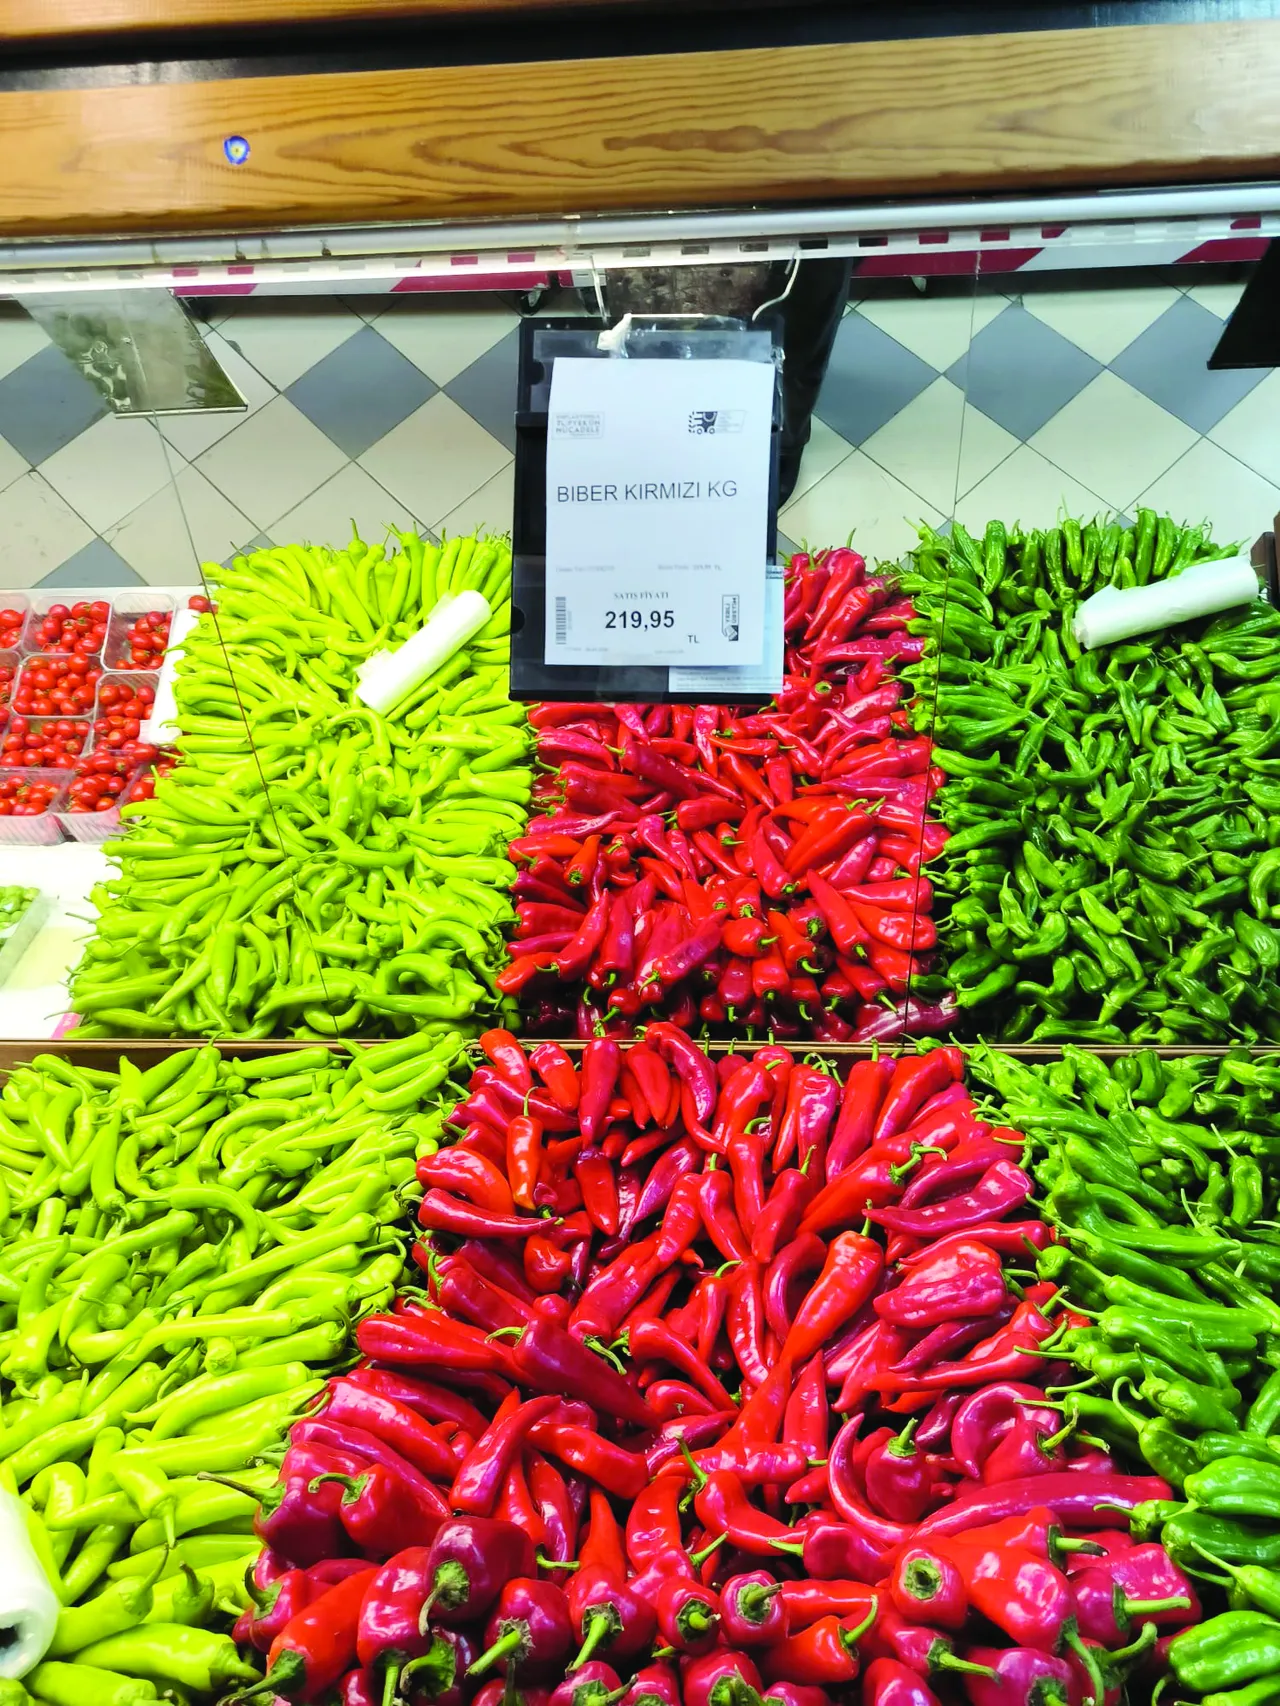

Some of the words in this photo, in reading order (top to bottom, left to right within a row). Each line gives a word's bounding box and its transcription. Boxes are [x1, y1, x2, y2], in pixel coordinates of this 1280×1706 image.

[557, 485, 618, 502] BIBER
[625, 482, 700, 500] KIRMIZI
[708, 480, 737, 498] KG
[605, 610, 674, 632] 219,95
[687, 635, 700, 643] TL
